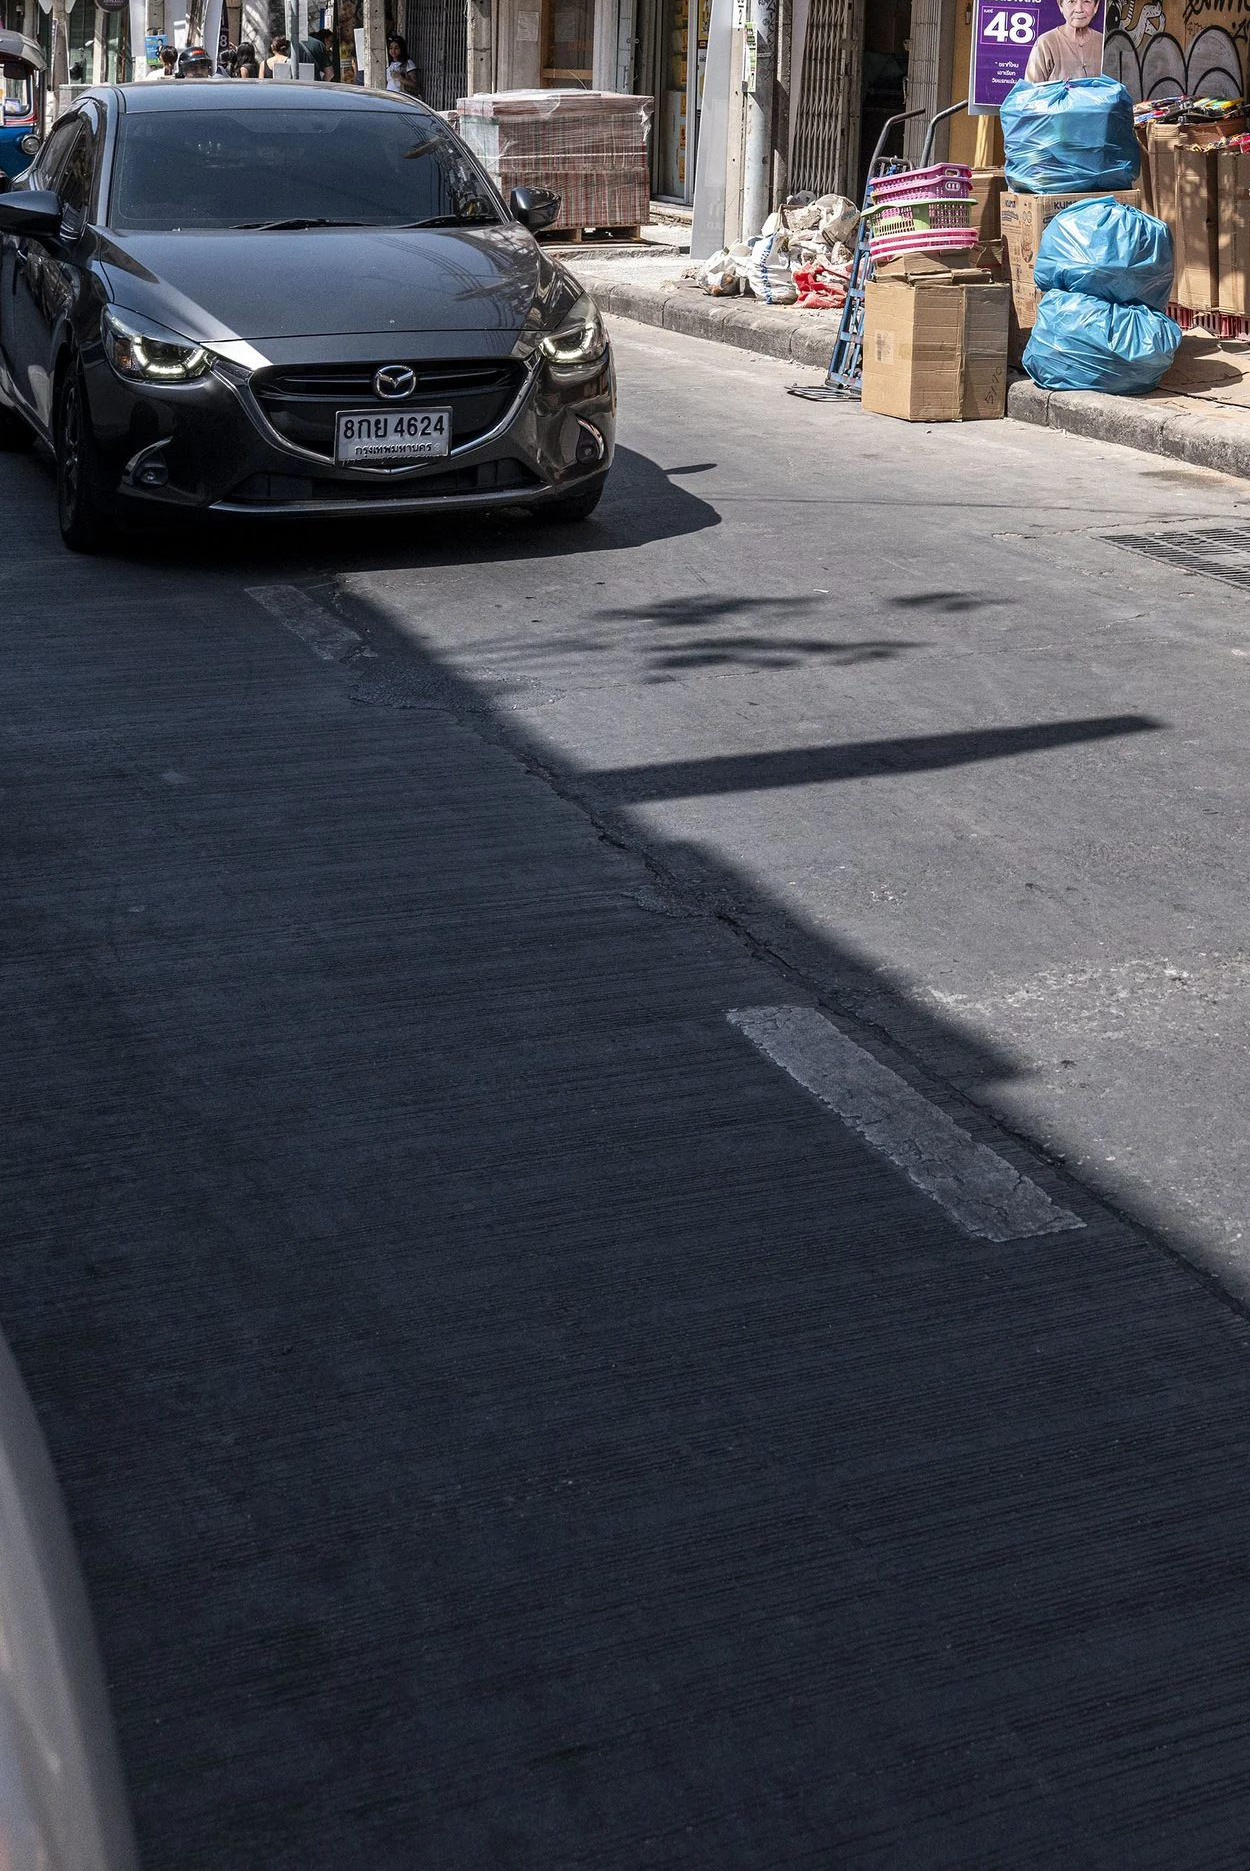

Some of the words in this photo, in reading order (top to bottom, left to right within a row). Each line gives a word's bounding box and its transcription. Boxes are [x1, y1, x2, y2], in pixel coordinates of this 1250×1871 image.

[983, 11, 1036, 44] 48
[343, 417, 388, 439] 8กย
[393, 414, 445, 438] 4624
[355, 442, 433, 458] กรุงเทพมหานคร
